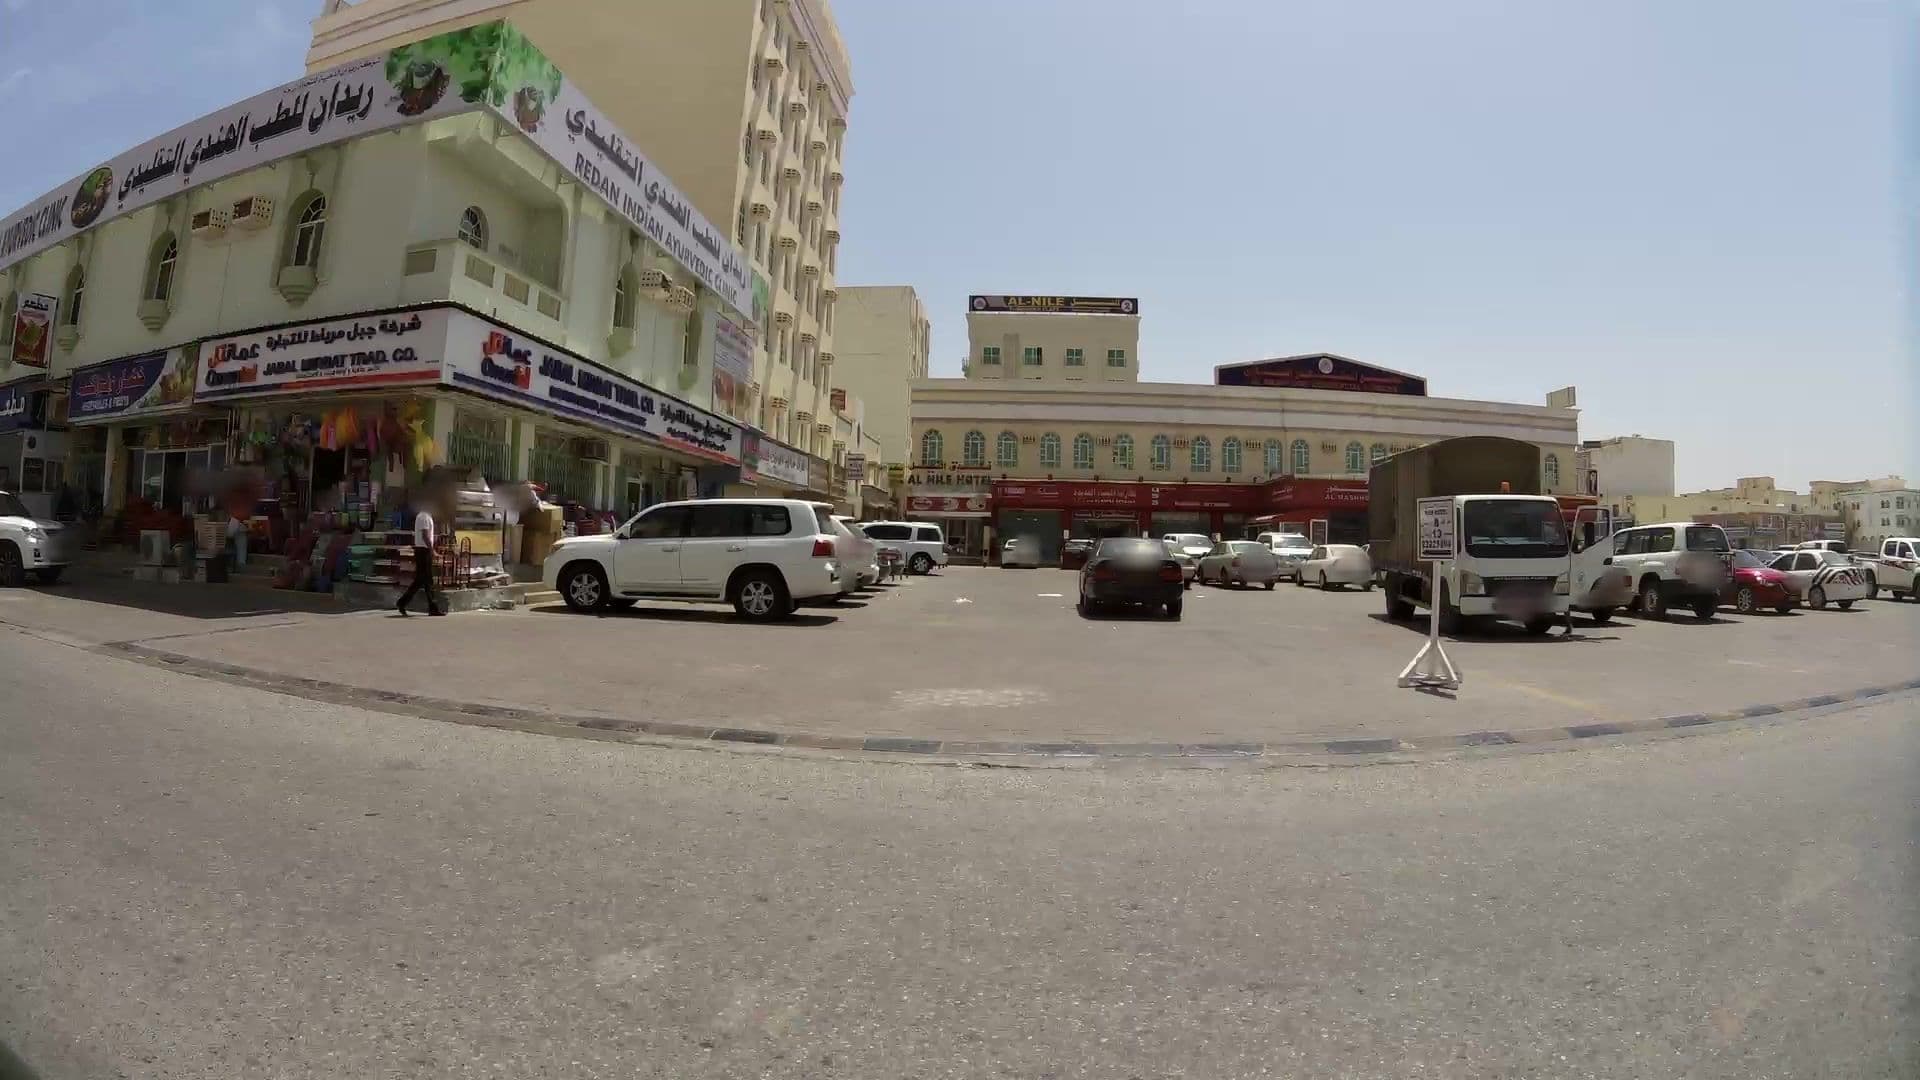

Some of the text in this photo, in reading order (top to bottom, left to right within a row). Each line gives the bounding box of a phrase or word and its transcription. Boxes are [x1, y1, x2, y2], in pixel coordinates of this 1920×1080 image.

[118, 80, 374, 210] ريدان للطب الهندي التقليدي
[566, 107, 644, 187] التقليدي
[644, 182, 691, 232] الهندي
[574, 151, 738, 306] REDAN INDIAN AYURVEDIC CLINIC
[692, 222, 721, 260] للطب
[1007, 296, 1065, 307] AL-NILE
[266, 313, 422, 352] شركة جبل مرباط للتجارة
[263, 359, 298, 376] JABAL
[392, 347, 418, 361] CO.
[908, 474, 992, 486] AL NILE HOTEL
